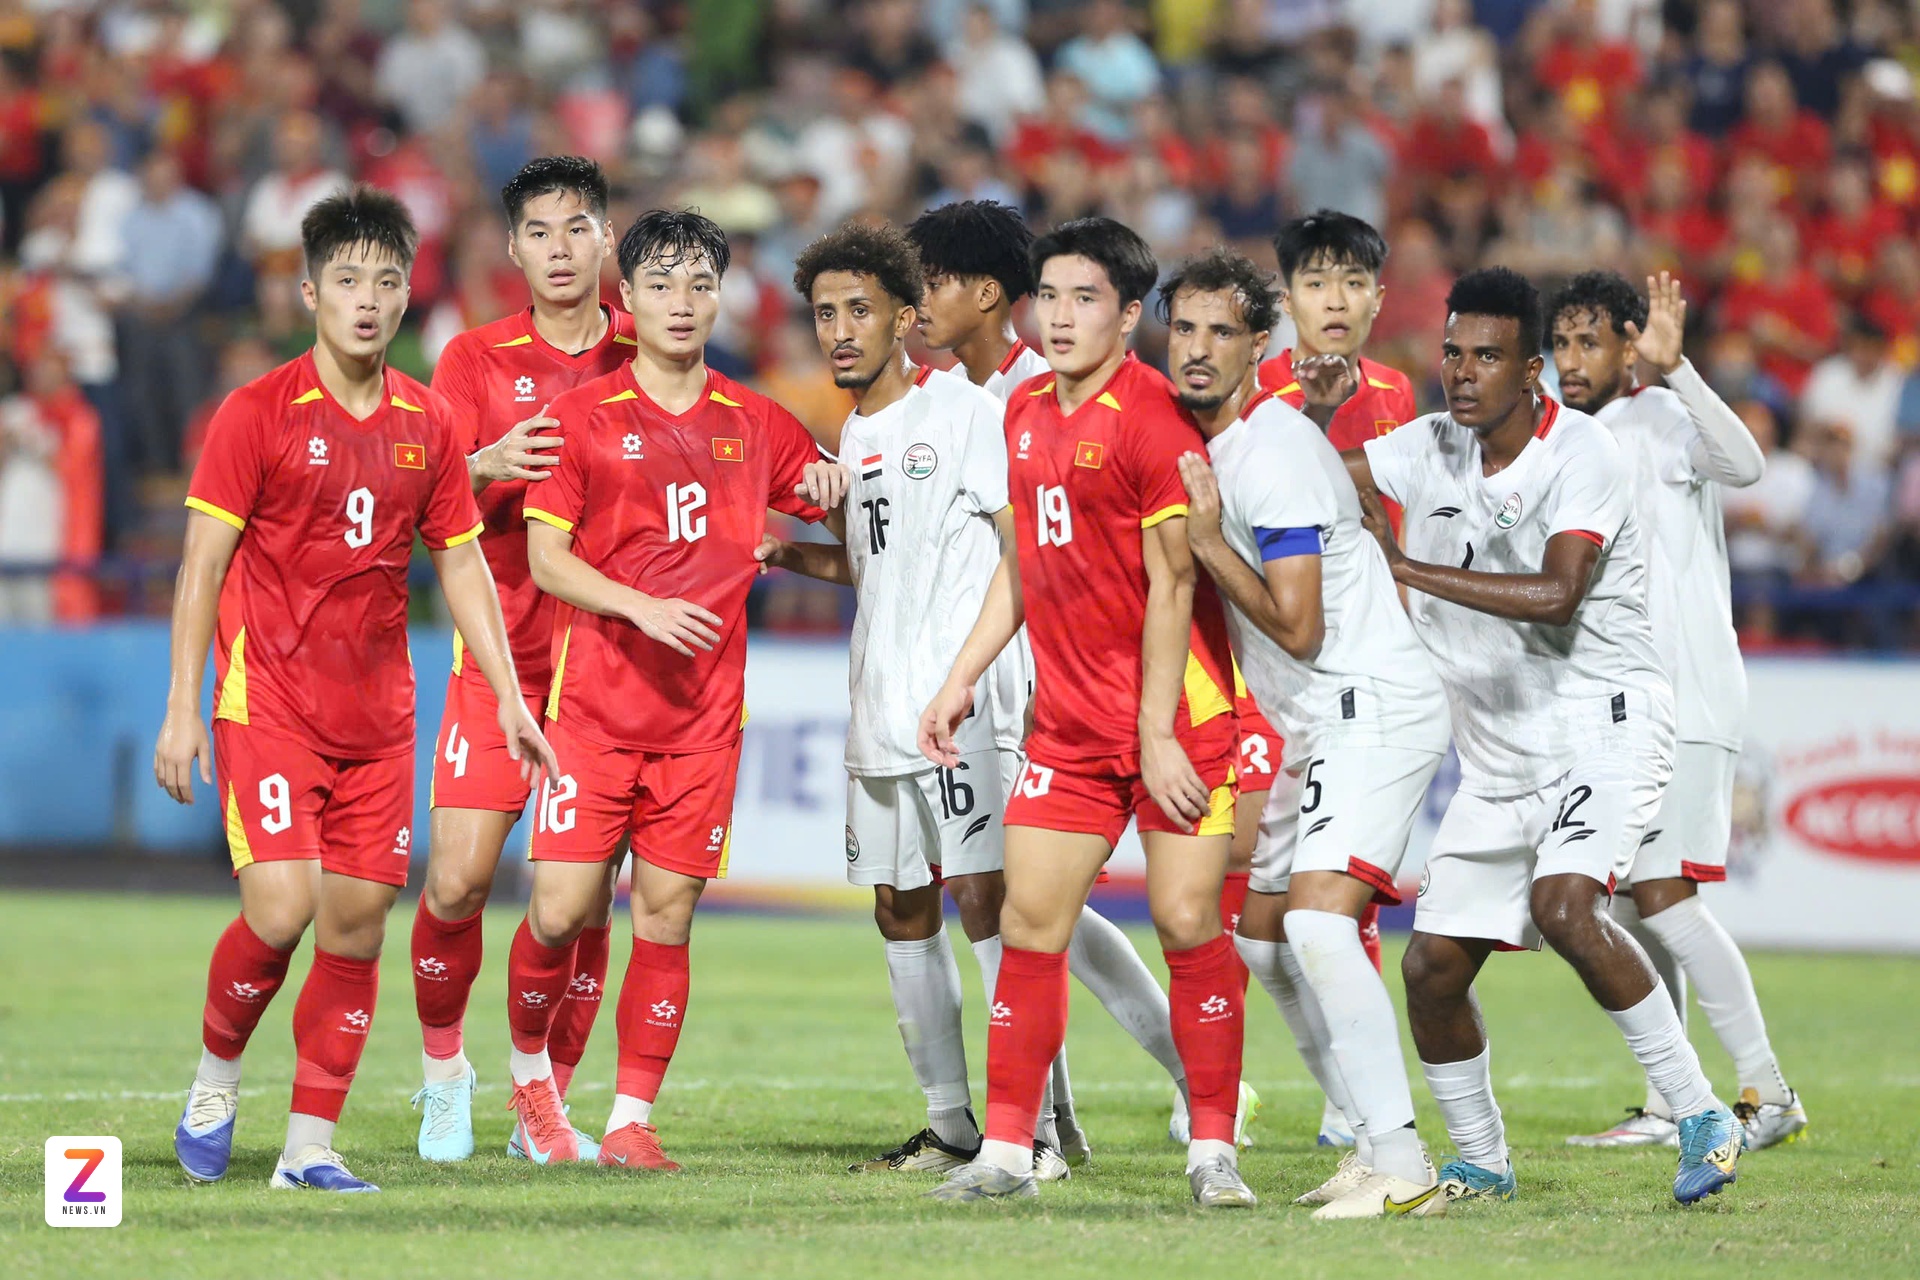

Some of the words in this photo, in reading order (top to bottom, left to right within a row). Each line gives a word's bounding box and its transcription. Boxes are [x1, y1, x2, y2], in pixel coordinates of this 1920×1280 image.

[344, 487, 375, 549] 9
[666, 481, 707, 543] 12
[1036, 484, 1073, 548] 19
[444, 722, 470, 778] 4
[259, 773, 292, 835] 9
[539, 774, 578, 834] 12
[935, 761, 975, 819] 16
[1300, 759, 1325, 814] 5
[1551, 784, 1593, 833] 12
